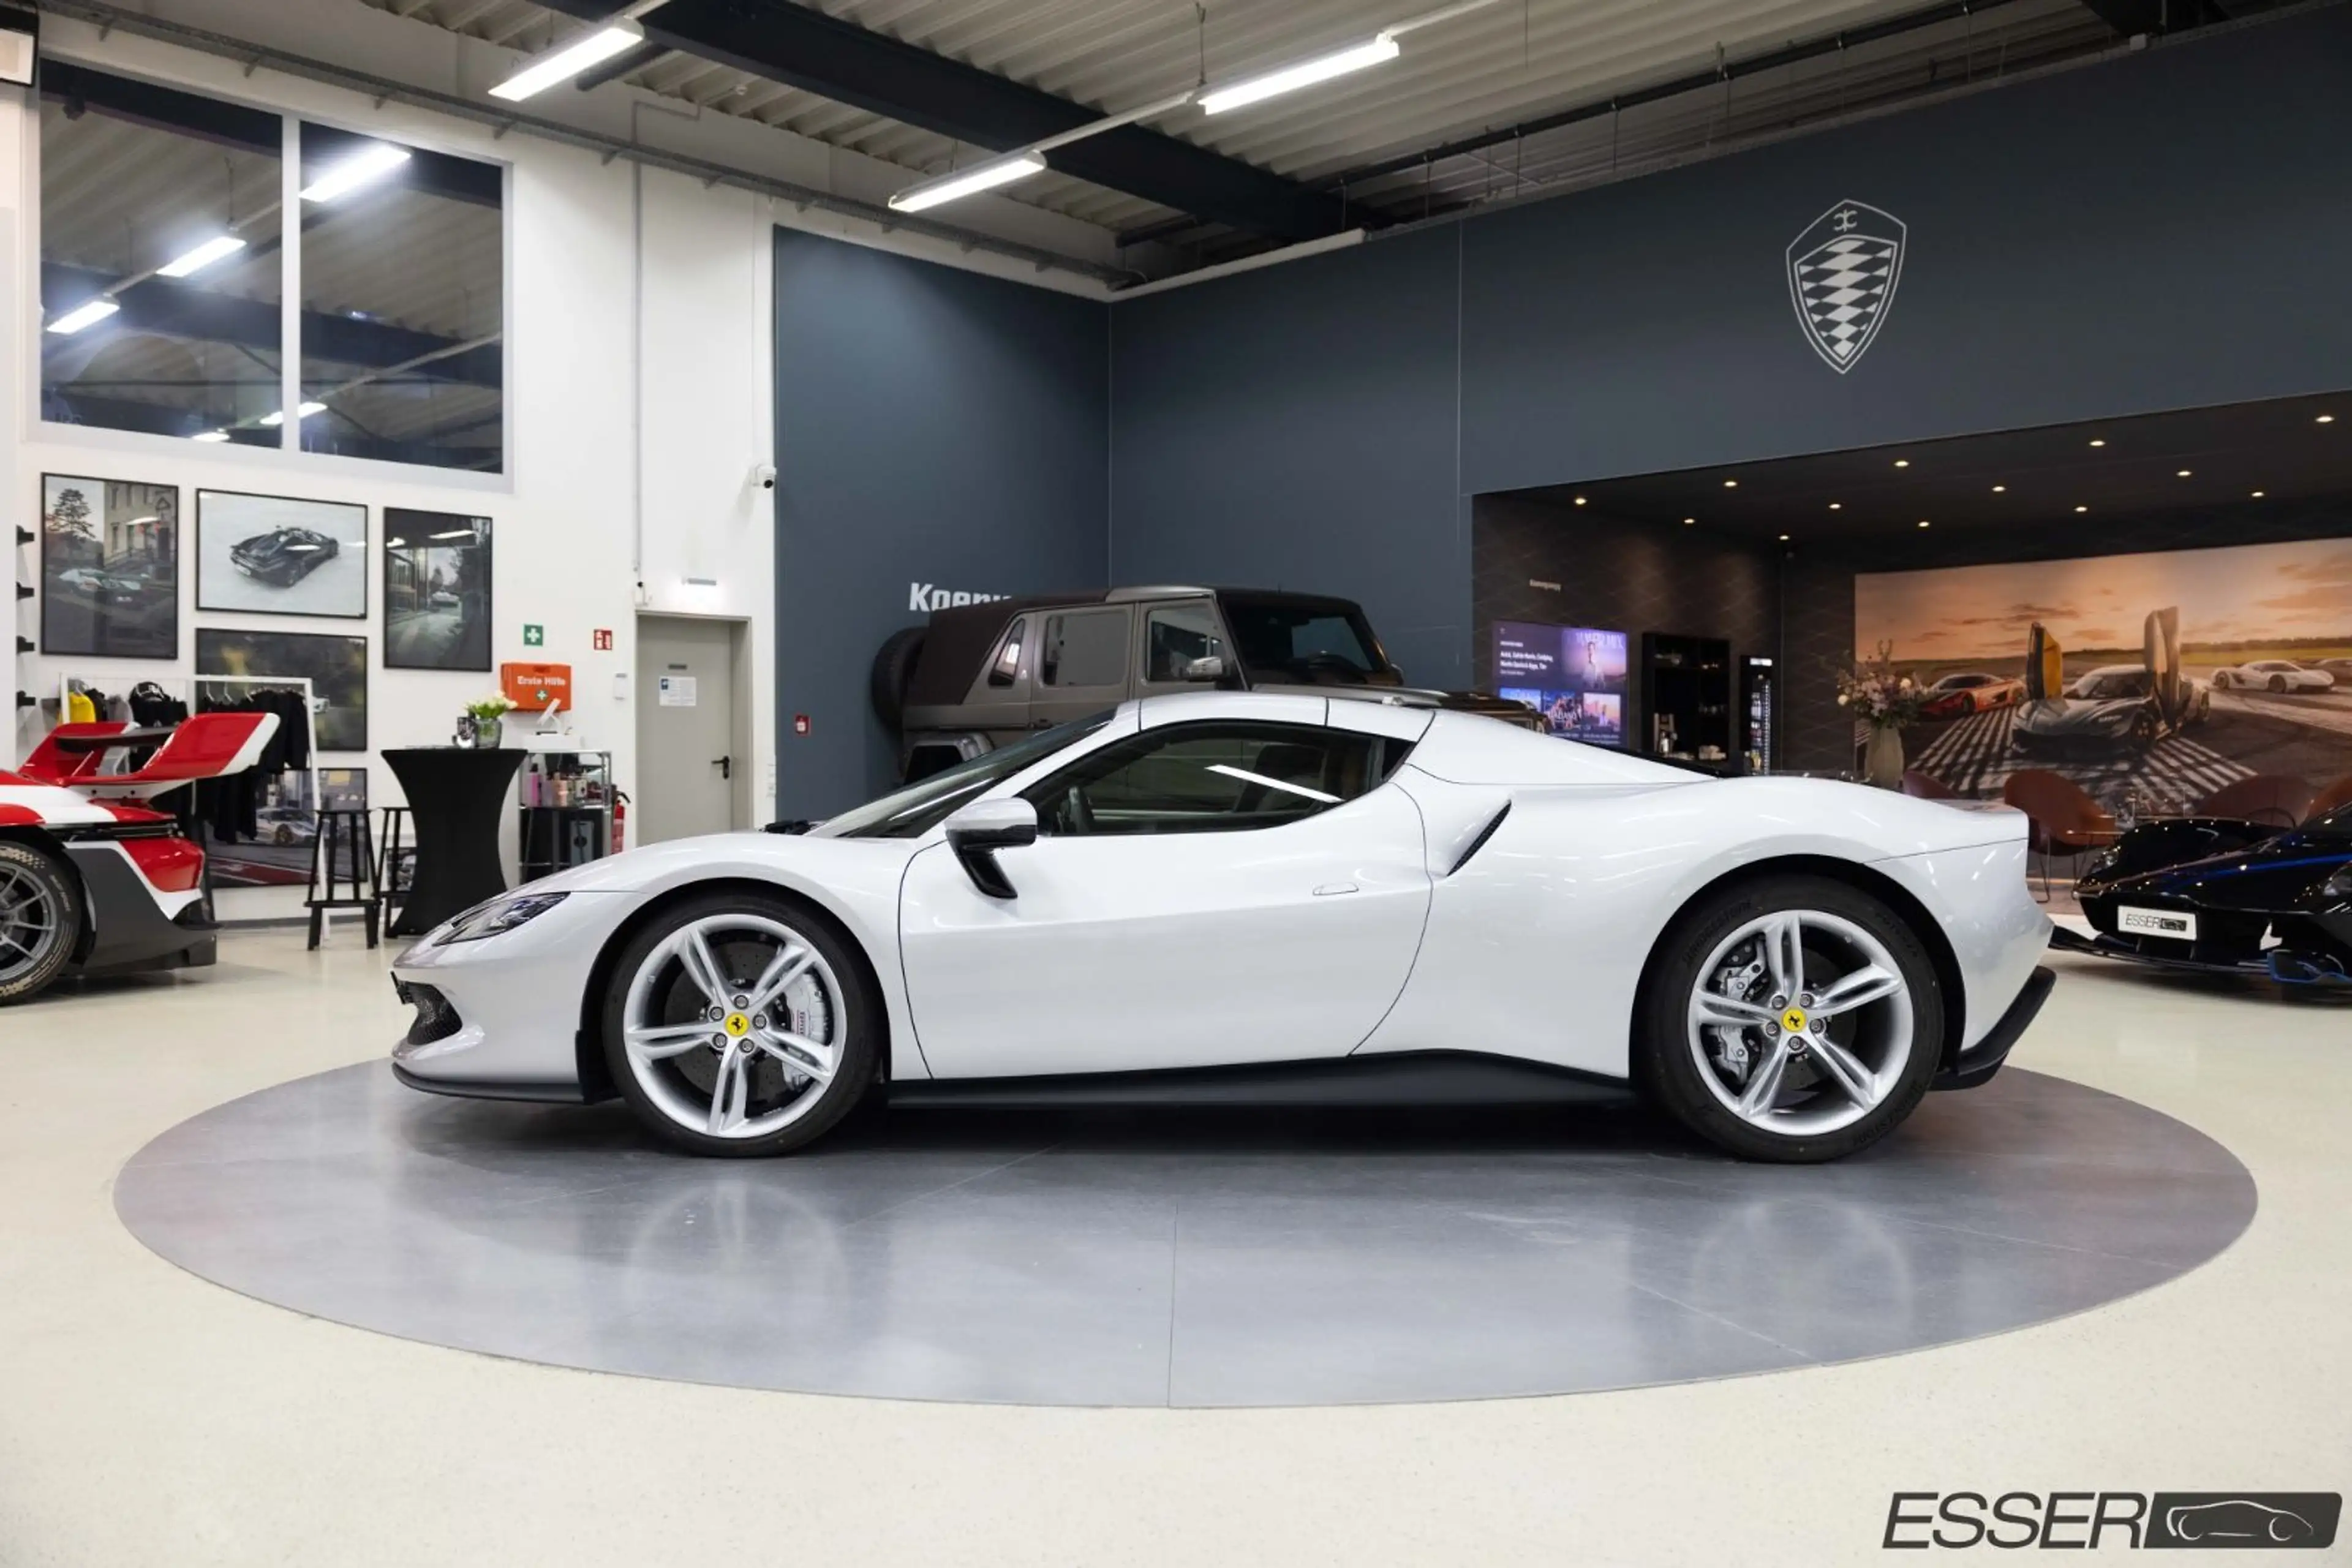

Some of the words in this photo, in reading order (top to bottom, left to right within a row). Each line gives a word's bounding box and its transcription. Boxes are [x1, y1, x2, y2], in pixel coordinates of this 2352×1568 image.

[517, 676, 543, 685] Erste
[544, 676, 566, 686] Hilfe
[2125, 914, 2162, 929] ESSER
